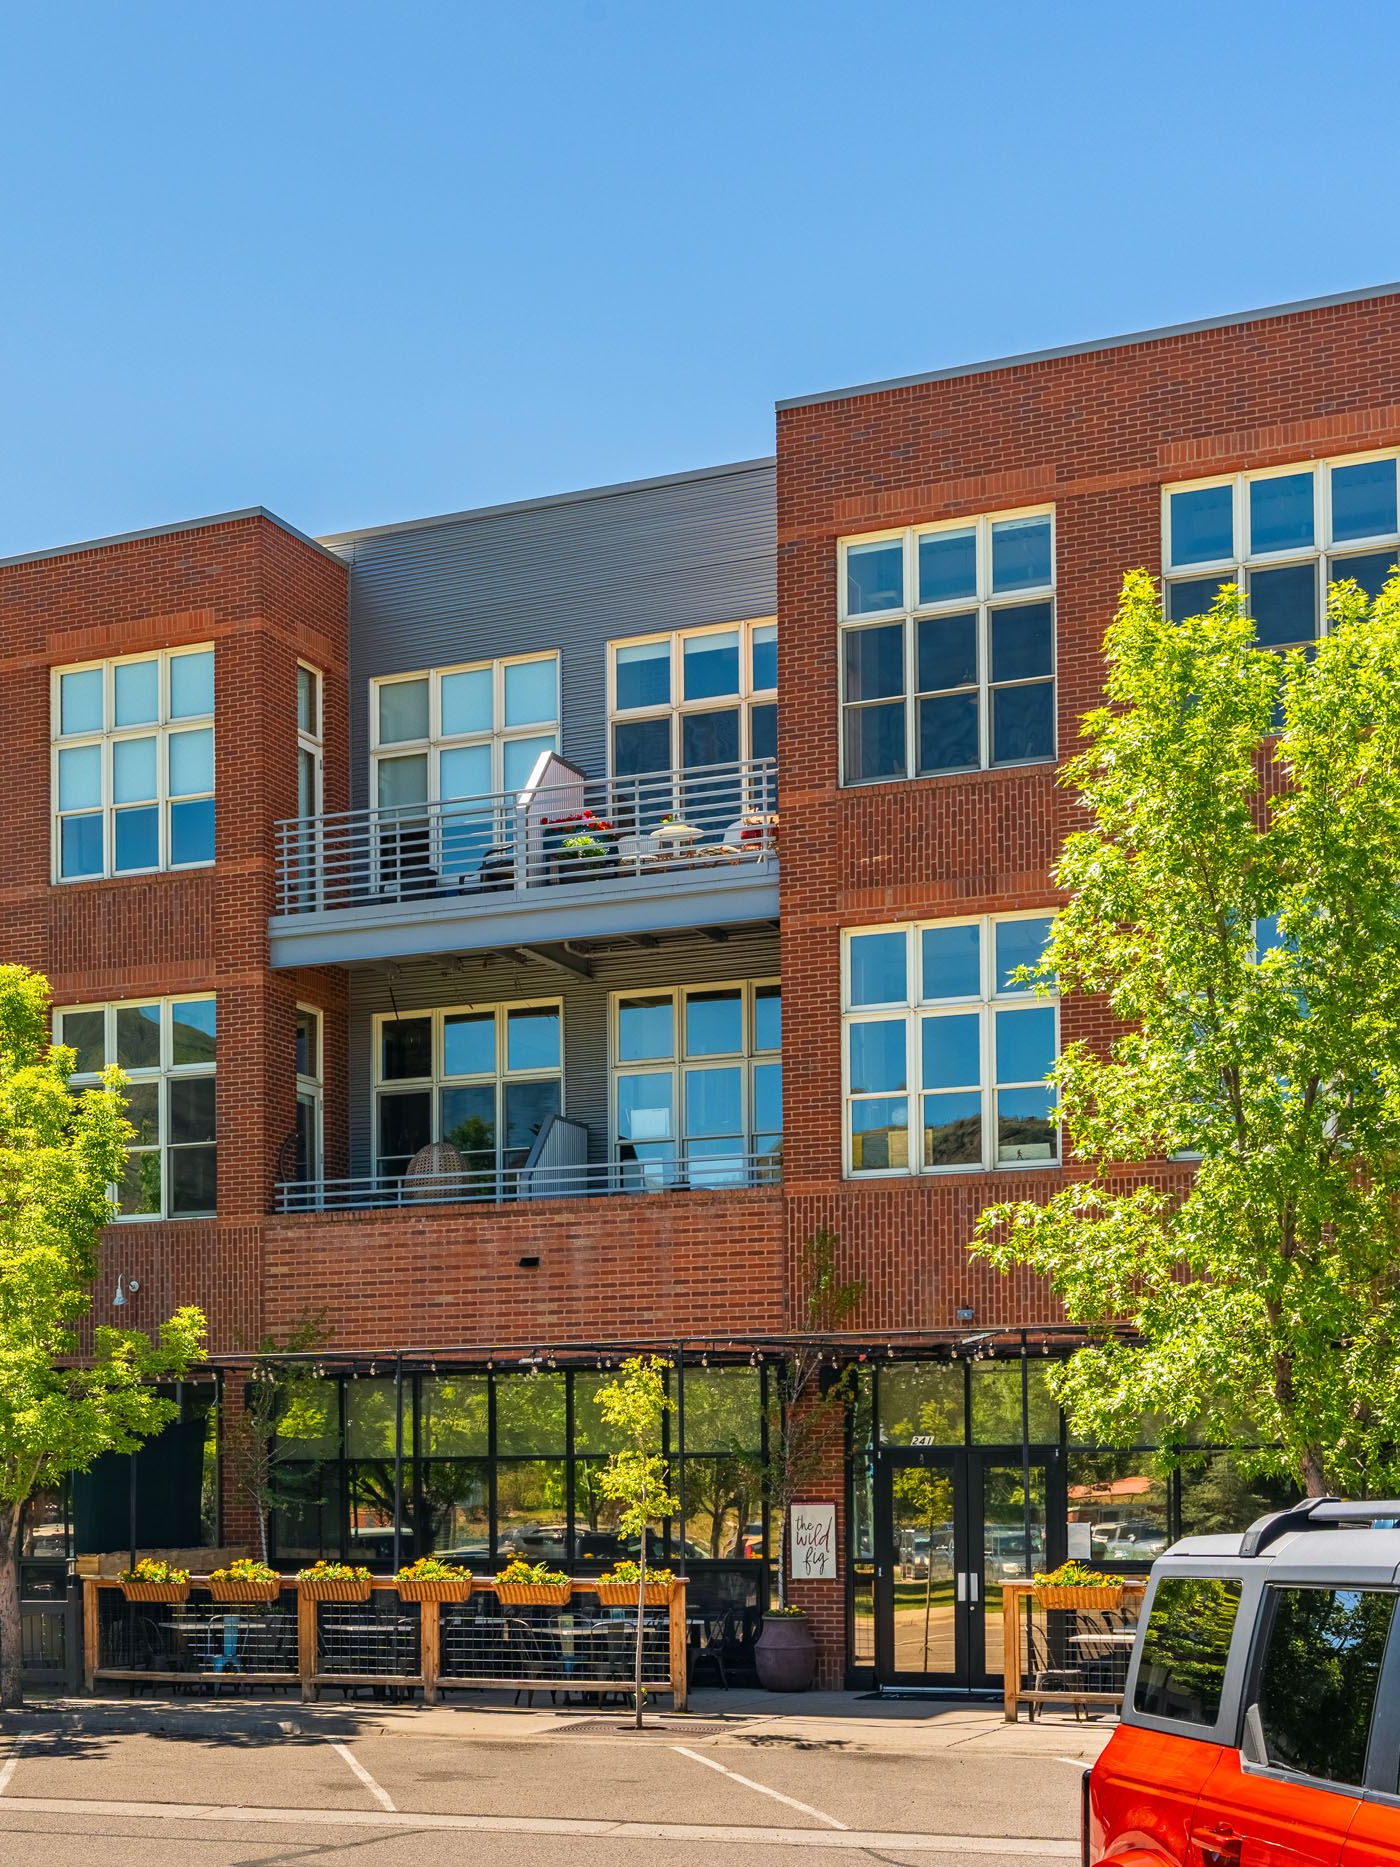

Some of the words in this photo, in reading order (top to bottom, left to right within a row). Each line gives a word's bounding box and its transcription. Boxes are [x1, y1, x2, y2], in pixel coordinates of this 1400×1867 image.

[912, 1436, 932, 1446] 241
[795, 1515, 815, 1531] the
[796, 1516, 833, 1553] wild
[802, 1546, 830, 1576] fig
